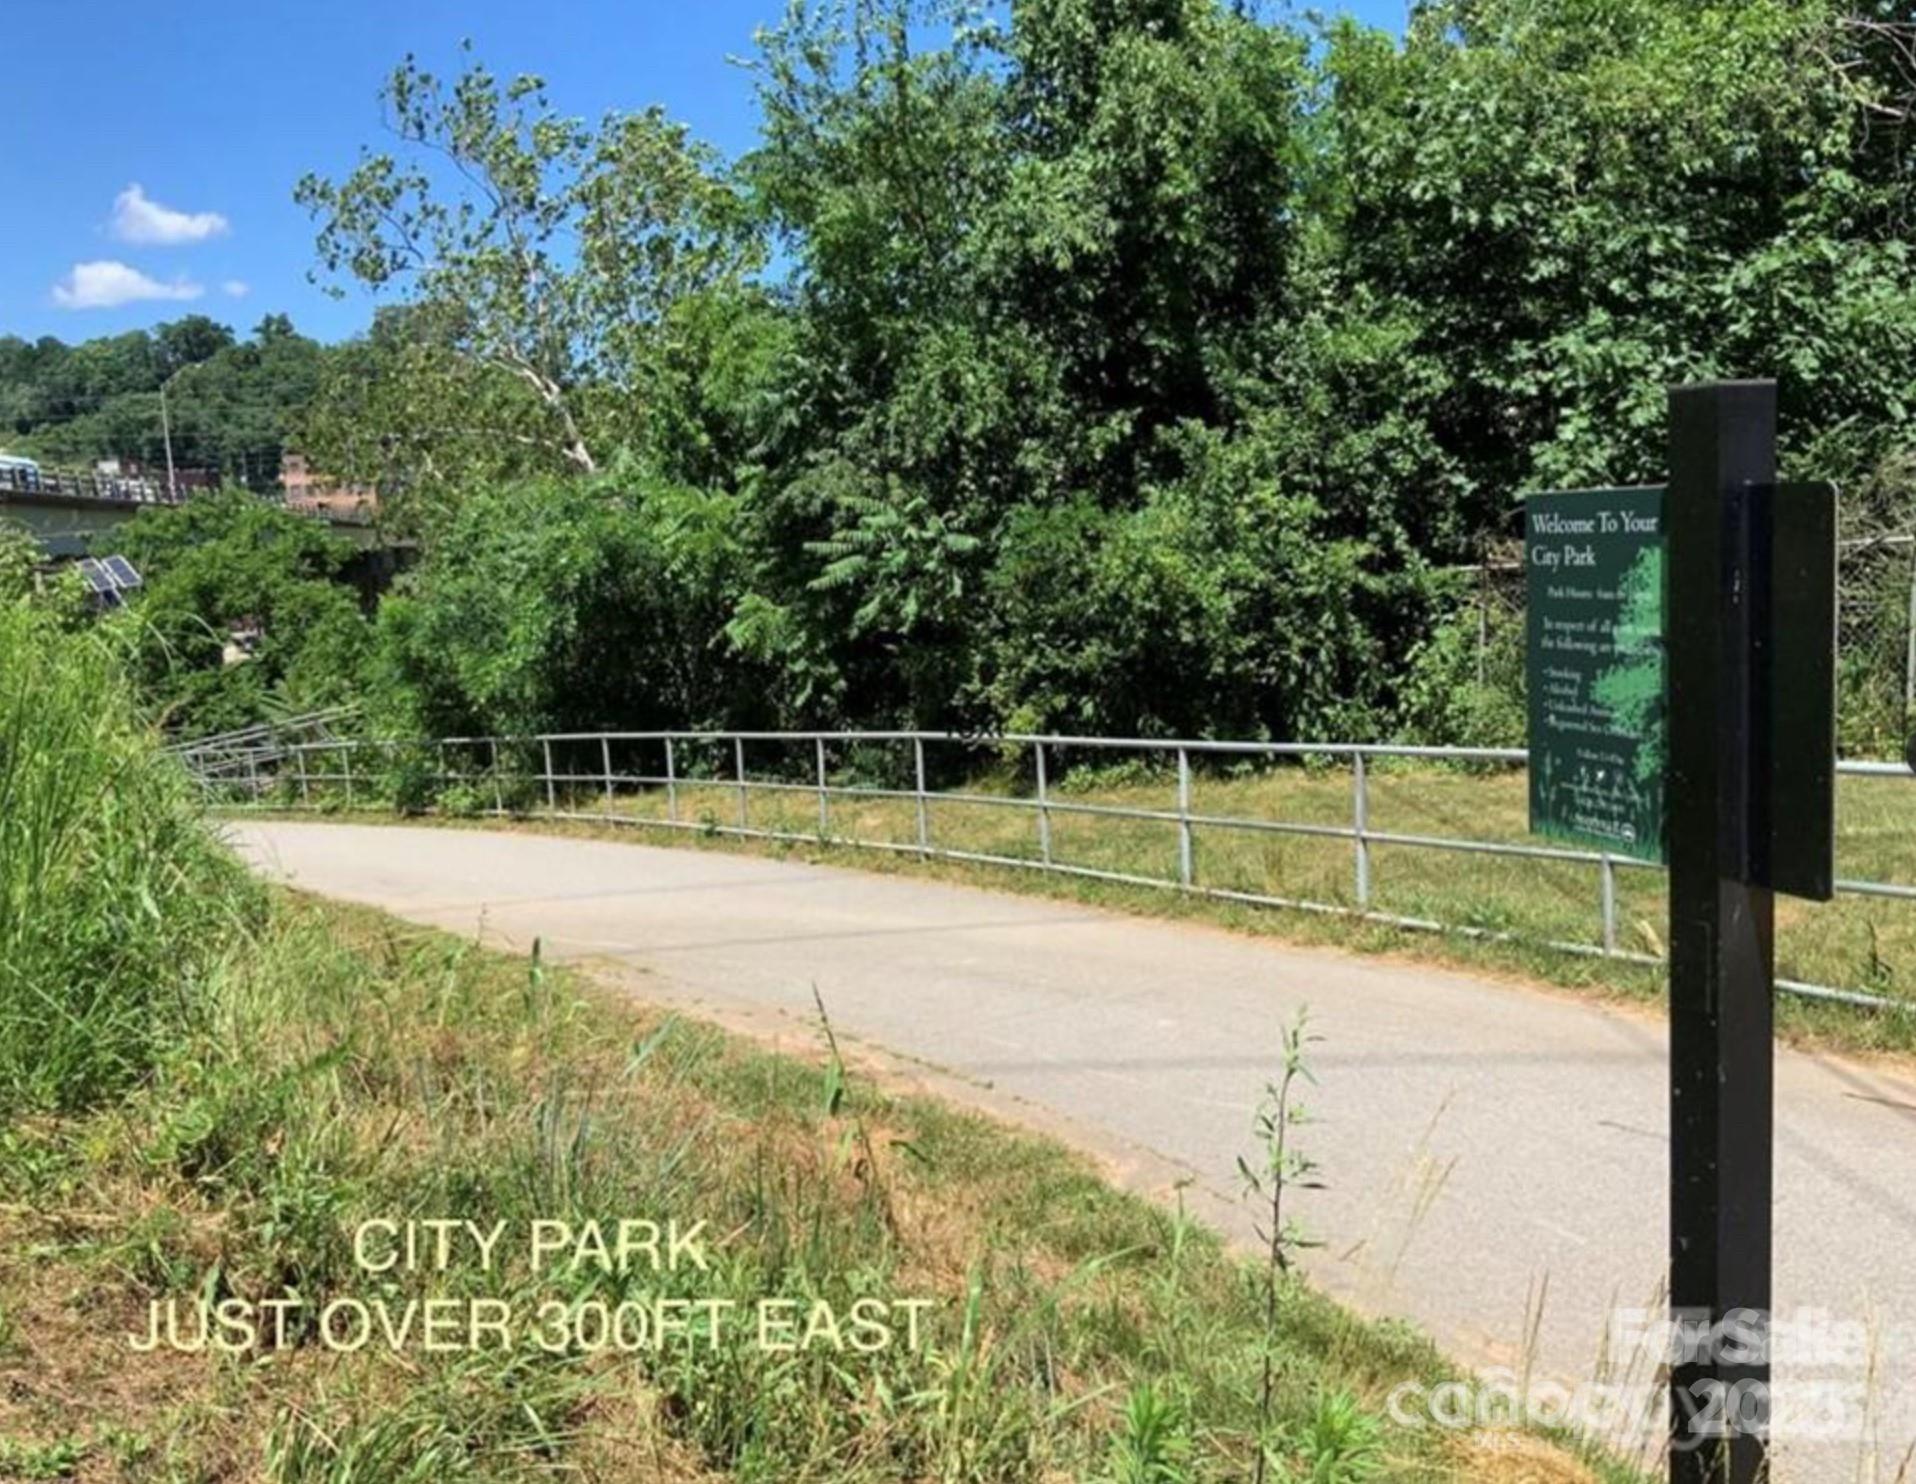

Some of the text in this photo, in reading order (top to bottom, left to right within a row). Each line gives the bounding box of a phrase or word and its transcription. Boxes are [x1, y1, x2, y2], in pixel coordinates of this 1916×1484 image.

[1532, 510, 1659, 534] Welcome To Your
[1531, 545, 1596, 573] City Park
